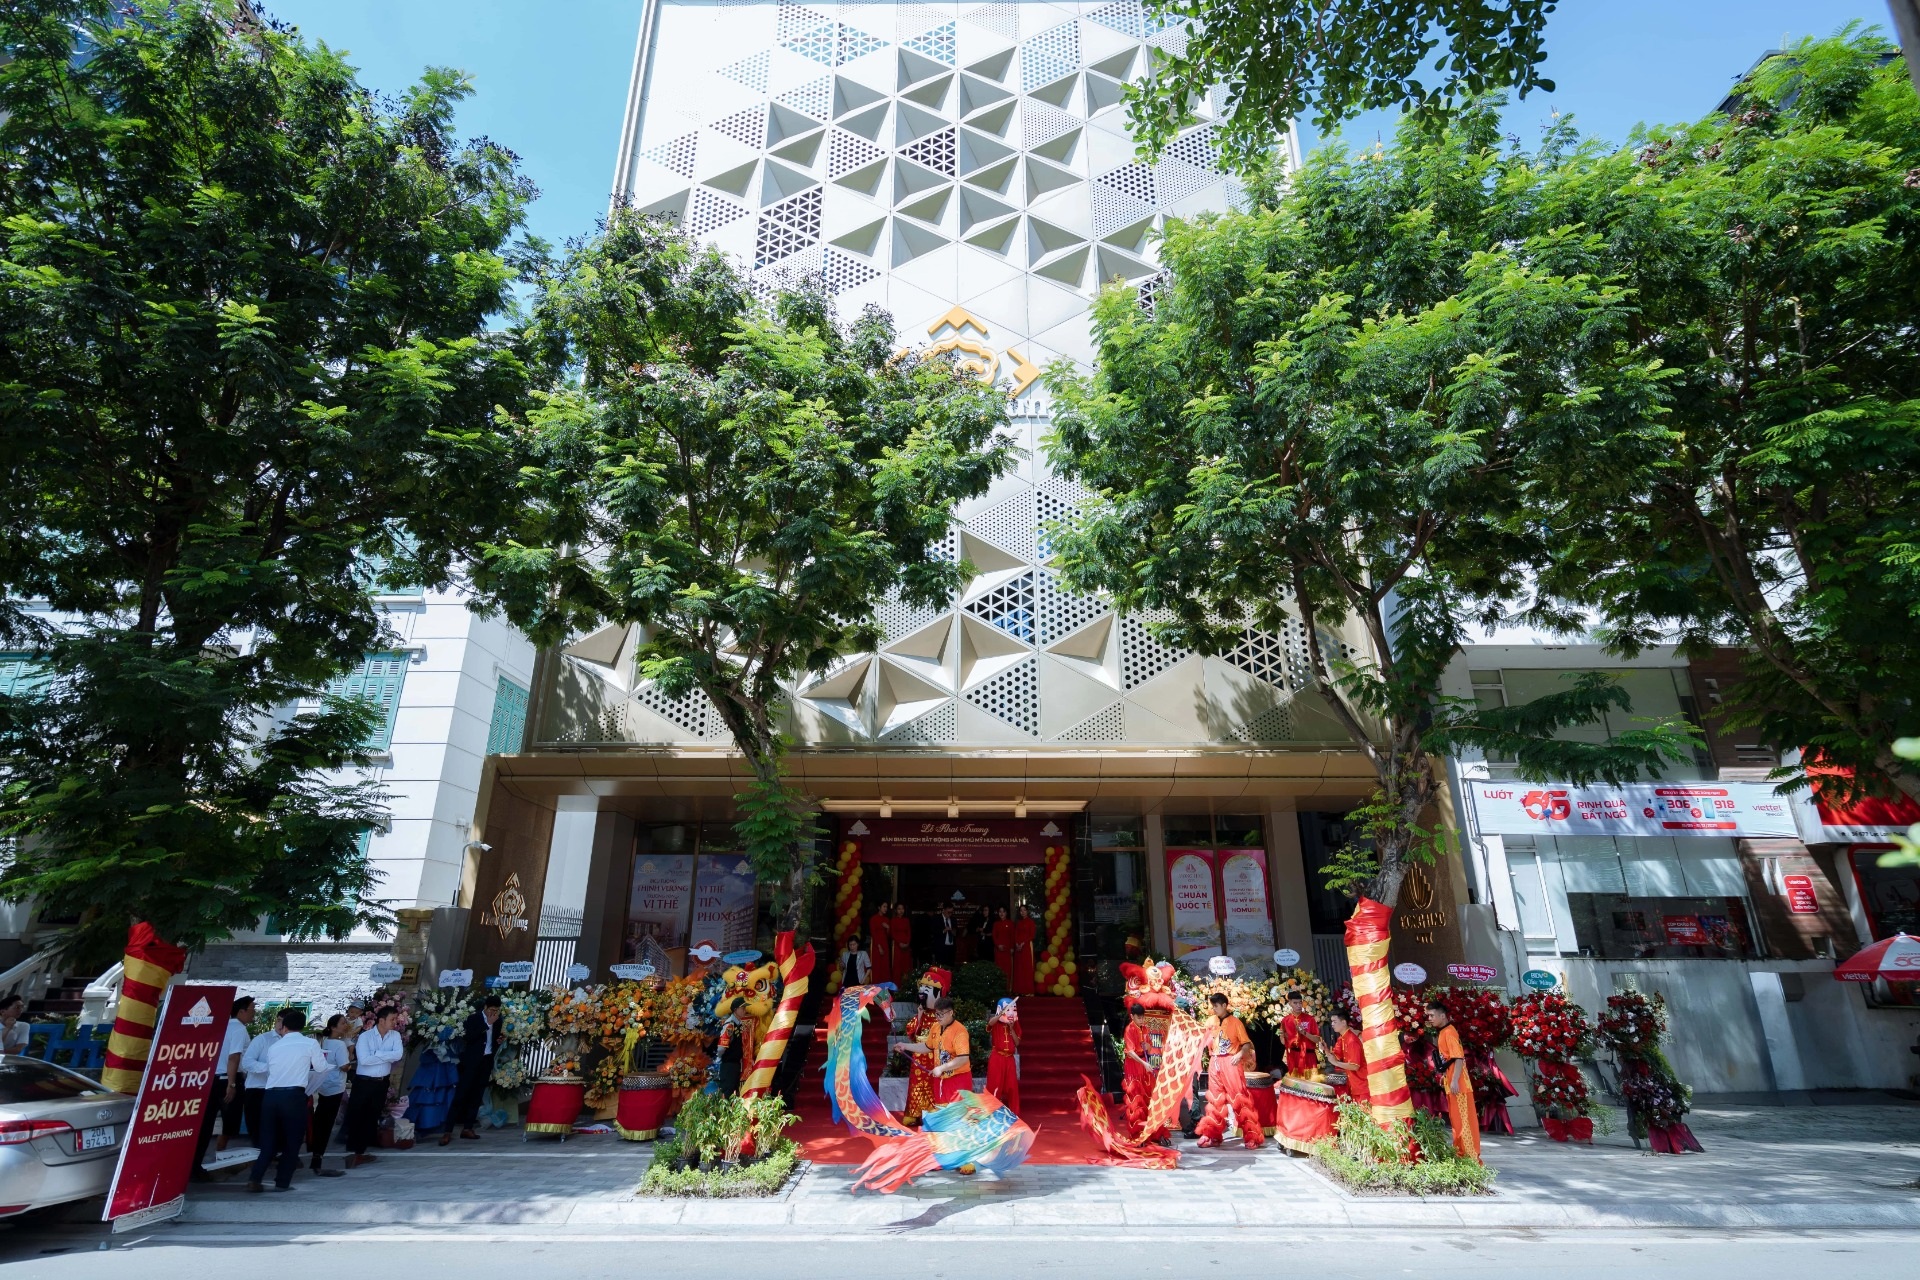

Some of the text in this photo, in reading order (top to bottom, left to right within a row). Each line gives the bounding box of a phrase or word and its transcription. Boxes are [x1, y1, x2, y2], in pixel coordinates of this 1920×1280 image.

[1484, 789, 1514, 800] LƯỚT
[1524, 790, 1571, 821] 5G
[1577, 797, 1627, 809] RINH QUÀ
[1666, 799, 1691, 809] 306
[1714, 800, 1736, 809] 918
[1752, 804, 1783, 812] viettel
[1582, 808, 1628, 820] BẤT NGỜ
[643, 899, 655, 912] VỊ
[1175, 899, 1212, 911] QUỐC TẾ
[697, 911, 736, 922] PHONG
[1841, 972, 1872, 980] viettel
[157, 1041, 220, 1065] DỊCH VỤ
[151, 1066, 211, 1092] HỖ TRỢ
[143, 1098, 202, 1125] ĐẬU XE
[91, 1128, 106, 1138] 20A
[138, 1128, 193, 1145] VALET PARKING
[86, 1136, 112, 1149] 974.31
